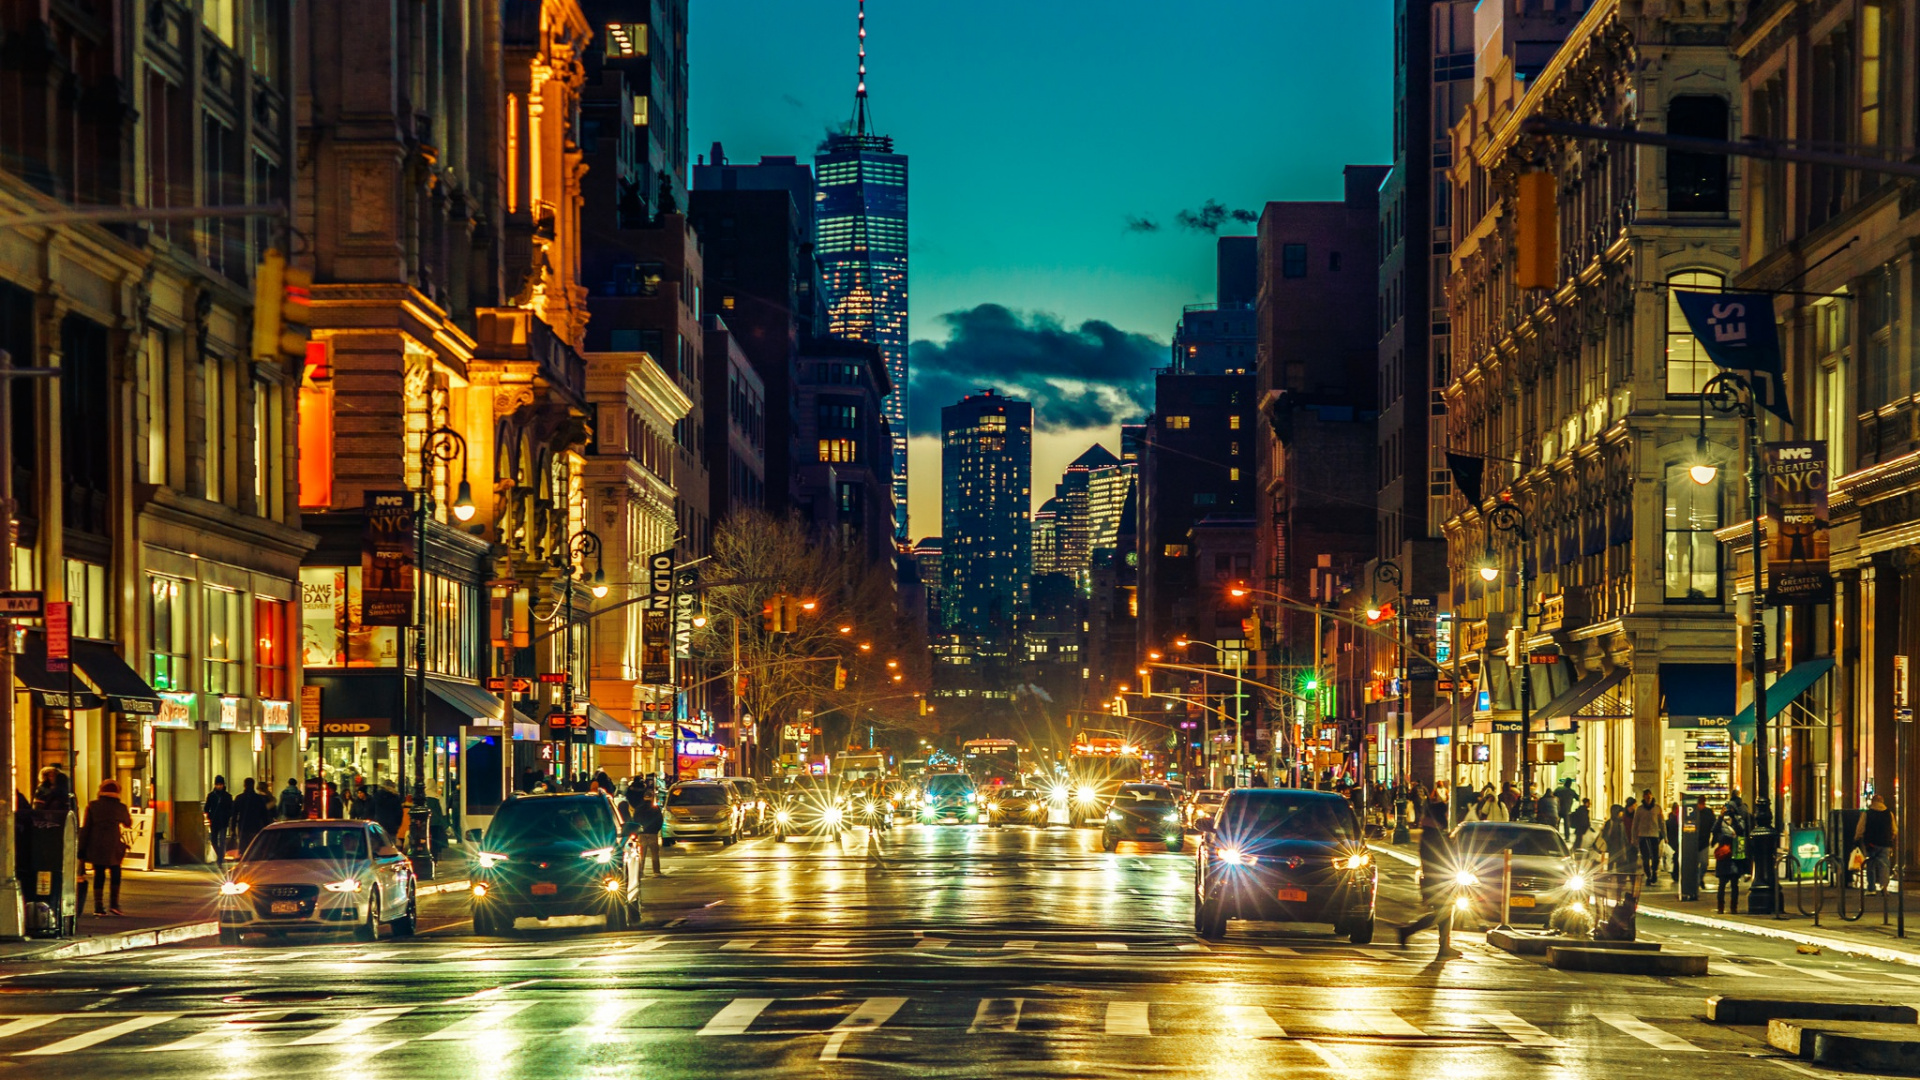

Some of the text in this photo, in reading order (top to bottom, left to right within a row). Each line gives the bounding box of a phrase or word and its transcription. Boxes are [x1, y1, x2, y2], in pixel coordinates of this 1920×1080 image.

[1779, 447, 1813, 460] NYC
[1767, 460, 1825, 475] GREATEST
[1772, 469, 1824, 495] NYC
[375, 496, 403, 506] NYC
[370, 514, 411, 533] NYC
[1784, 515, 1816, 524] nycgo
[653, 556, 671, 592] OLD
[1780, 576, 1821, 587] GREATEST
[303, 584, 332, 594] SAME
[1777, 582, 1823, 594] SHOWMAN
[7, 599, 33, 610] WAY
[303, 594, 331, 604] DAY
[645, 621, 669, 633] NYC
[676, 608, 692, 655] NAVY
[1495, 723, 1510, 731] The
[1698, 717, 1716, 726] The
[1686, 806, 1694, 817] P
